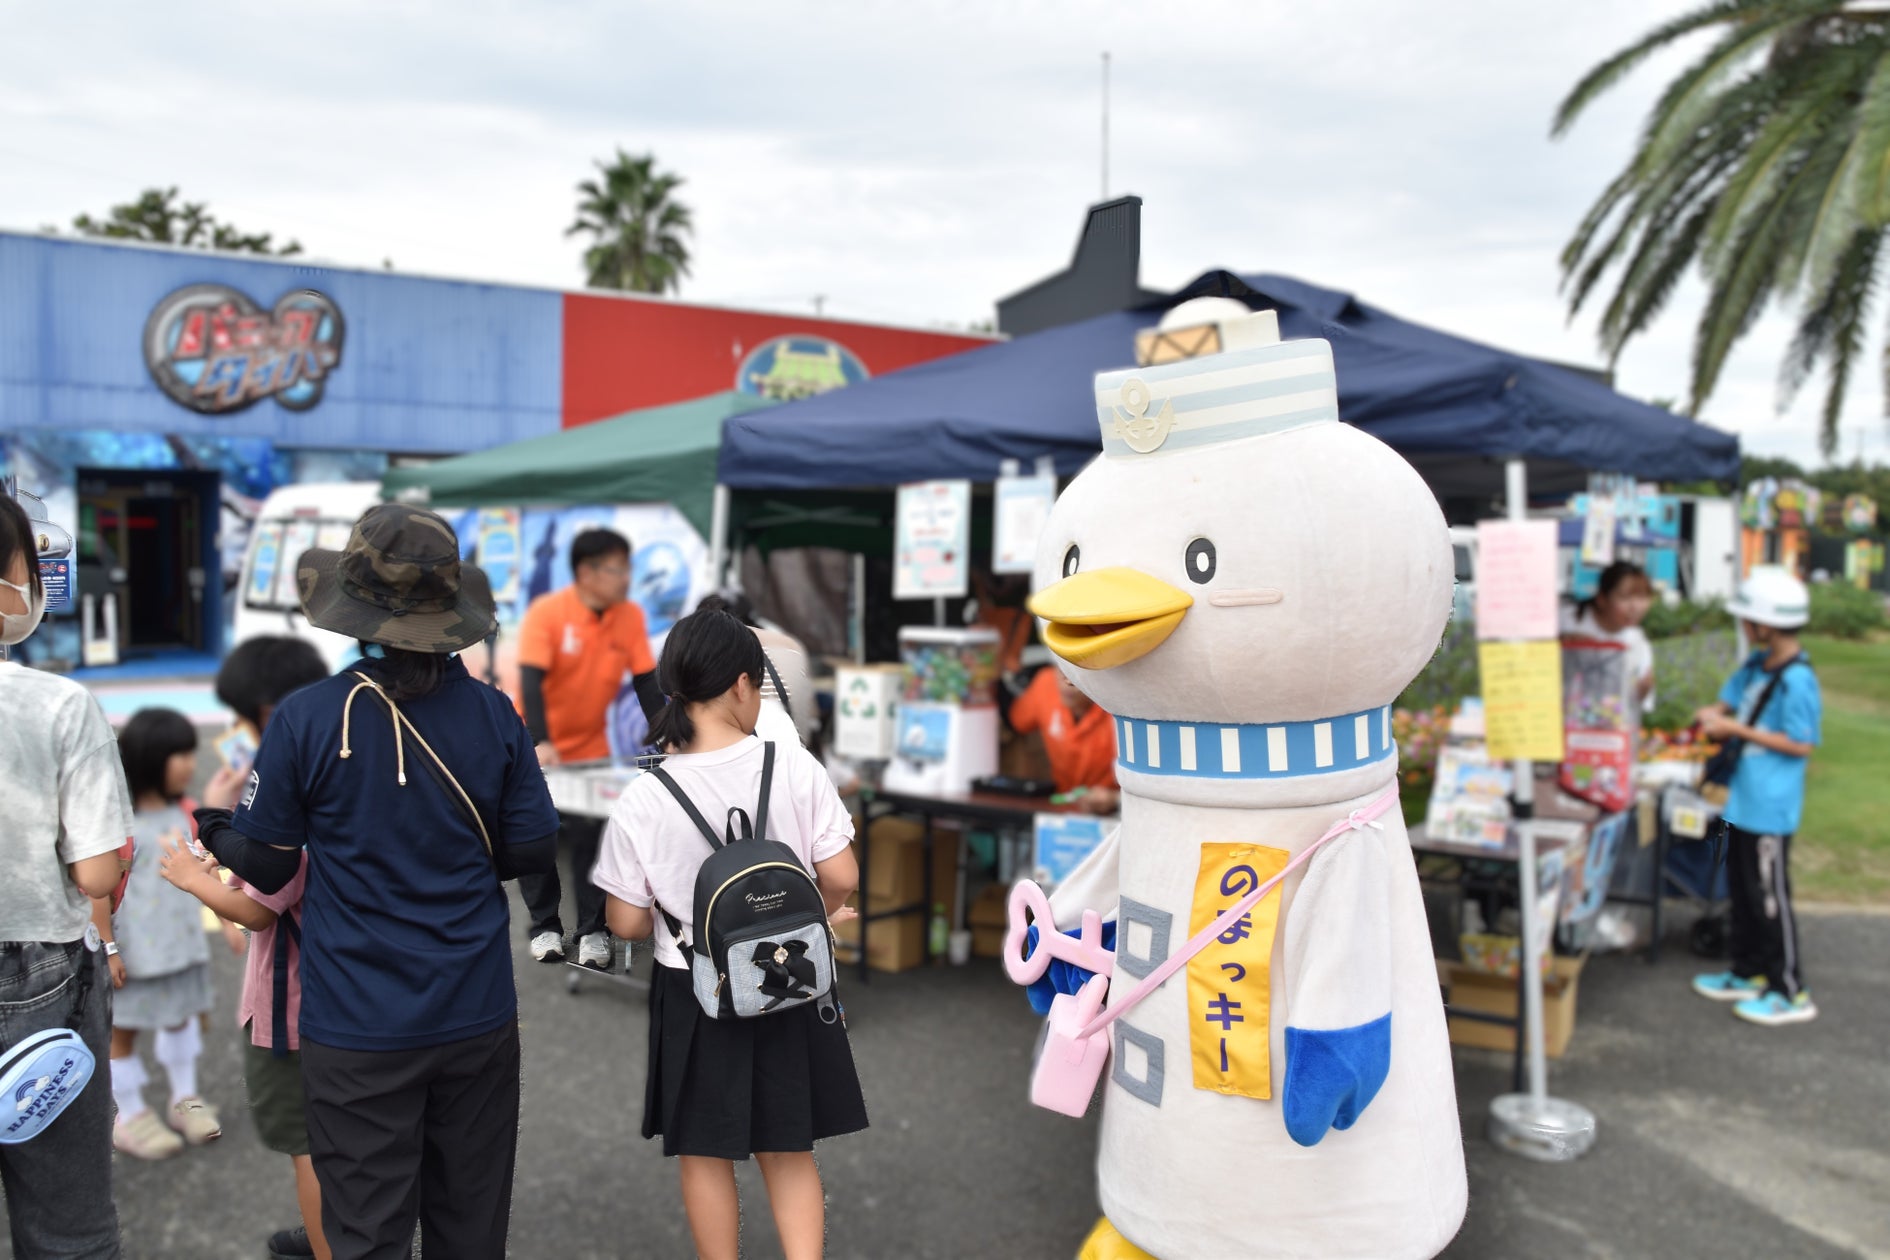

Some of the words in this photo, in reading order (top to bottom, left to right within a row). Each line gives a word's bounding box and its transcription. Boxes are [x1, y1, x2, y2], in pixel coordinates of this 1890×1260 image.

[1205, 864, 1259, 1072] のまっキー
[8, 1058, 74, 1132] HAPPINESS
[36, 1086, 67, 1118] DAYS
